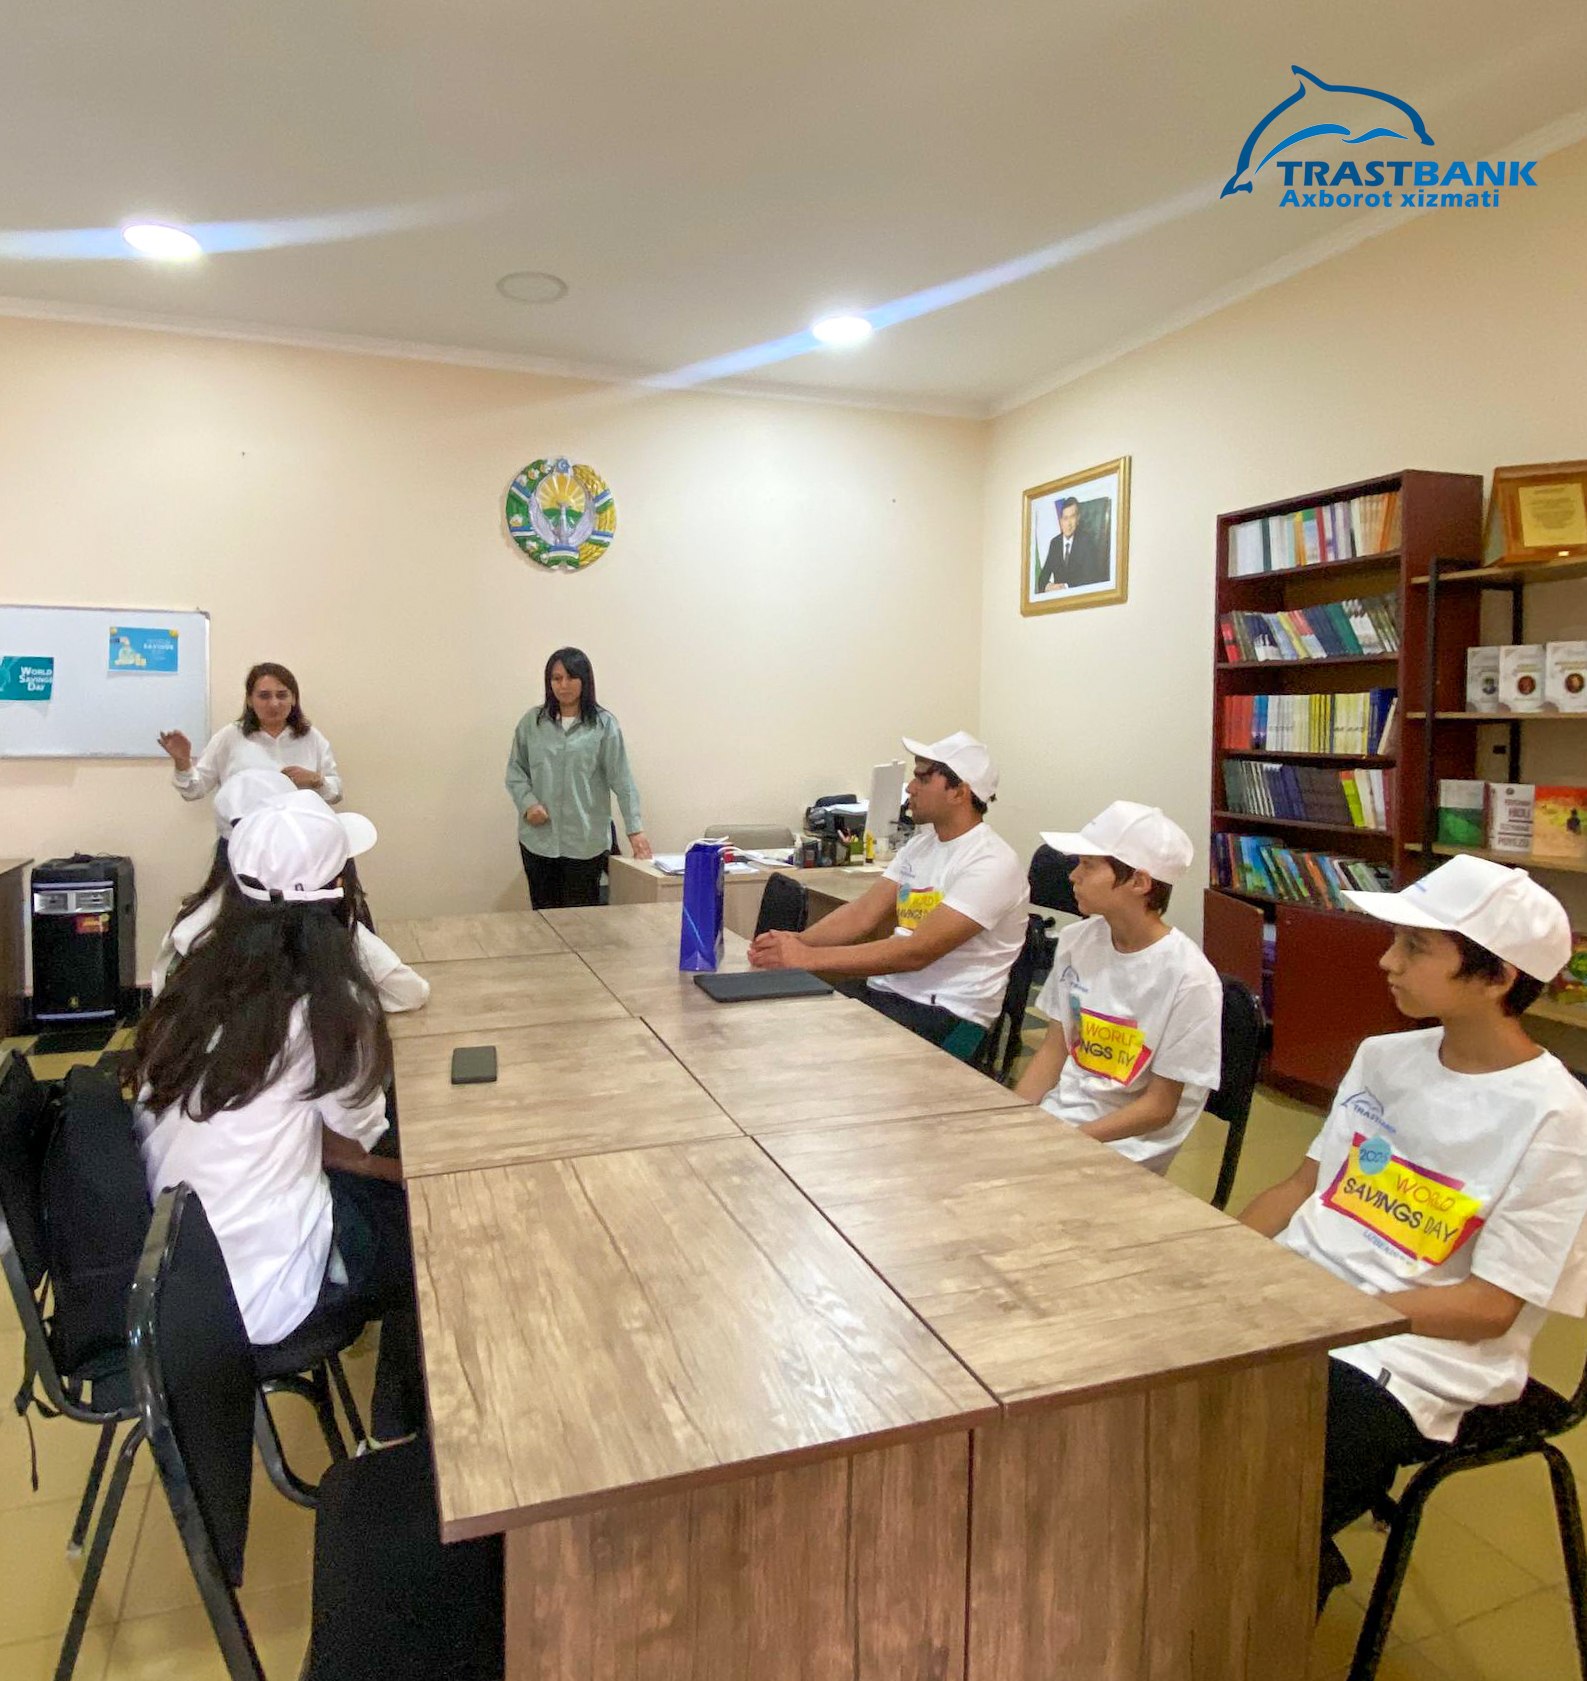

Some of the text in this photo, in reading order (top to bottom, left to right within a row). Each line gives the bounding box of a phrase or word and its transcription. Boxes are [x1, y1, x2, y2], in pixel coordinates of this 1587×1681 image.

[20, 666, 53, 676] WORLD
[1343, 1177, 1458, 1241] SAVINGS DAY
[1396, 1173, 1455, 1212] WORLD
